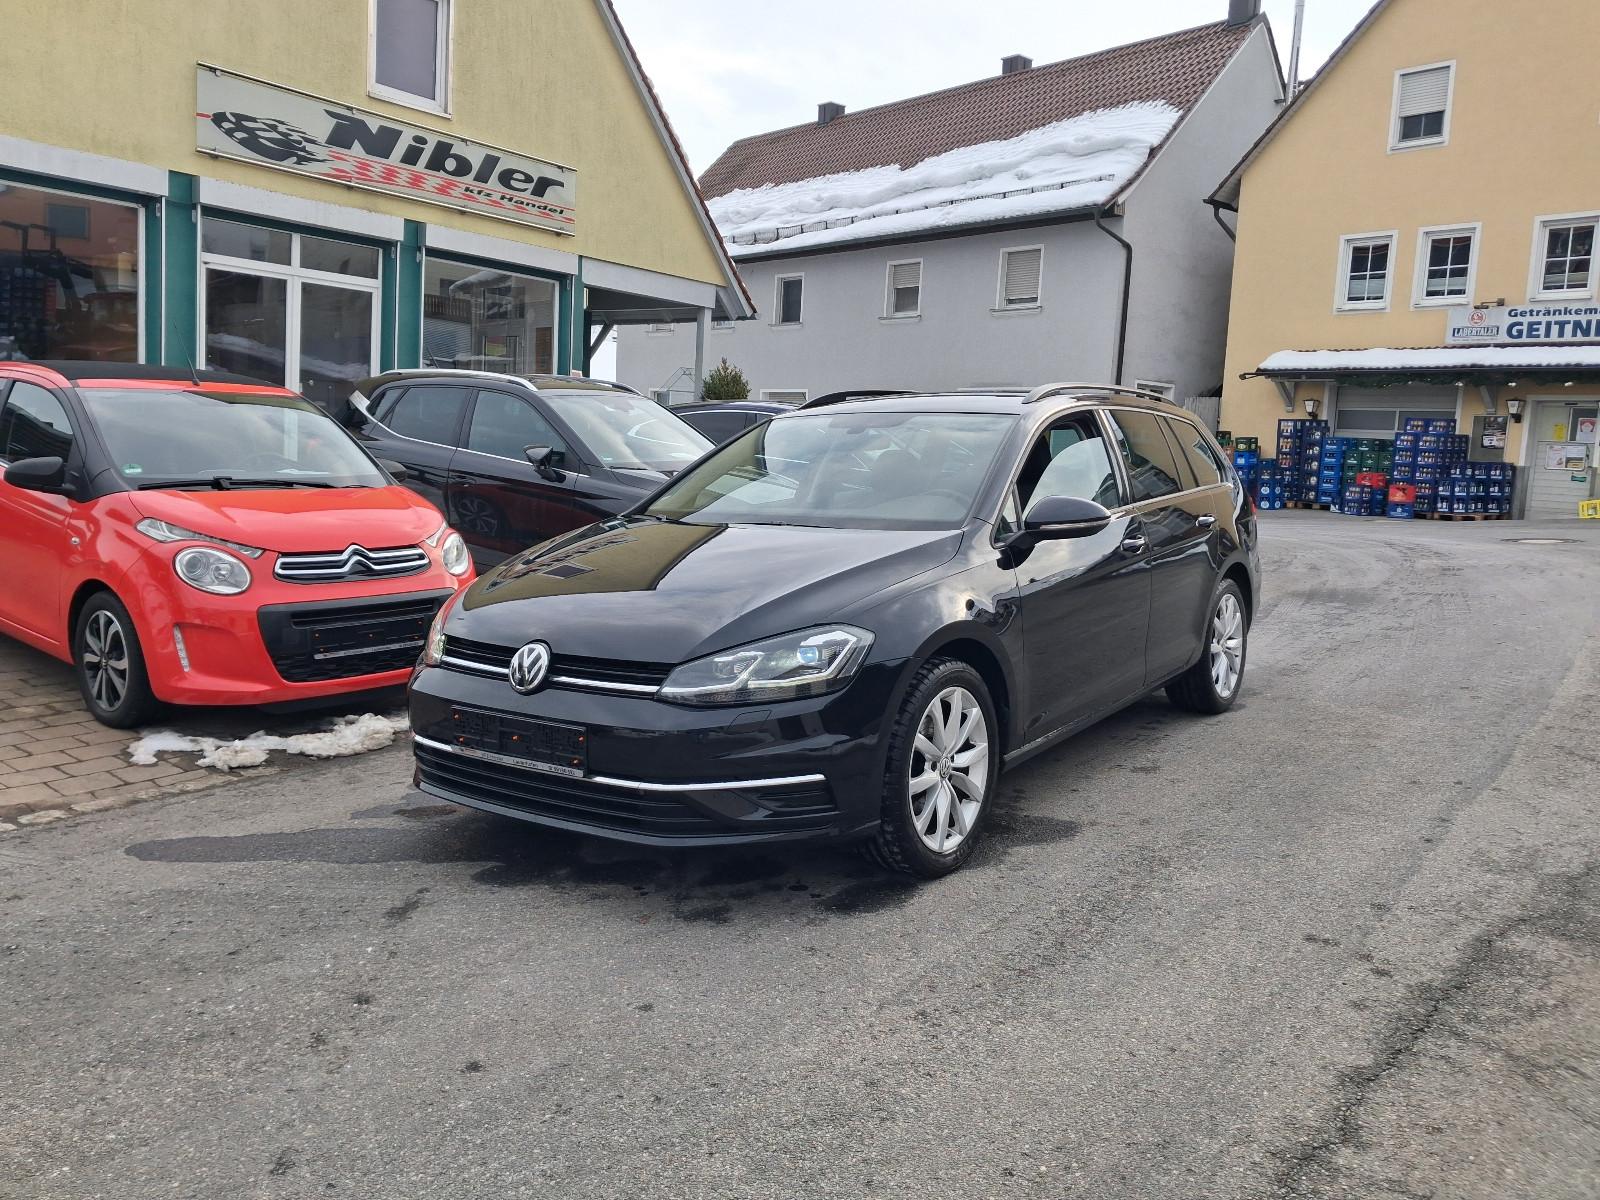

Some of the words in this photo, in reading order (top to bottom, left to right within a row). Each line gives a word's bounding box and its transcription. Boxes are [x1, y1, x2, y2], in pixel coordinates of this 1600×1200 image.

[323, 109, 564, 199] Nibler
[499, 194, 564, 215] Handel
[1507, 306, 1600, 318] Getränkem
[1454, 326, 1498, 337] LABERTALER
